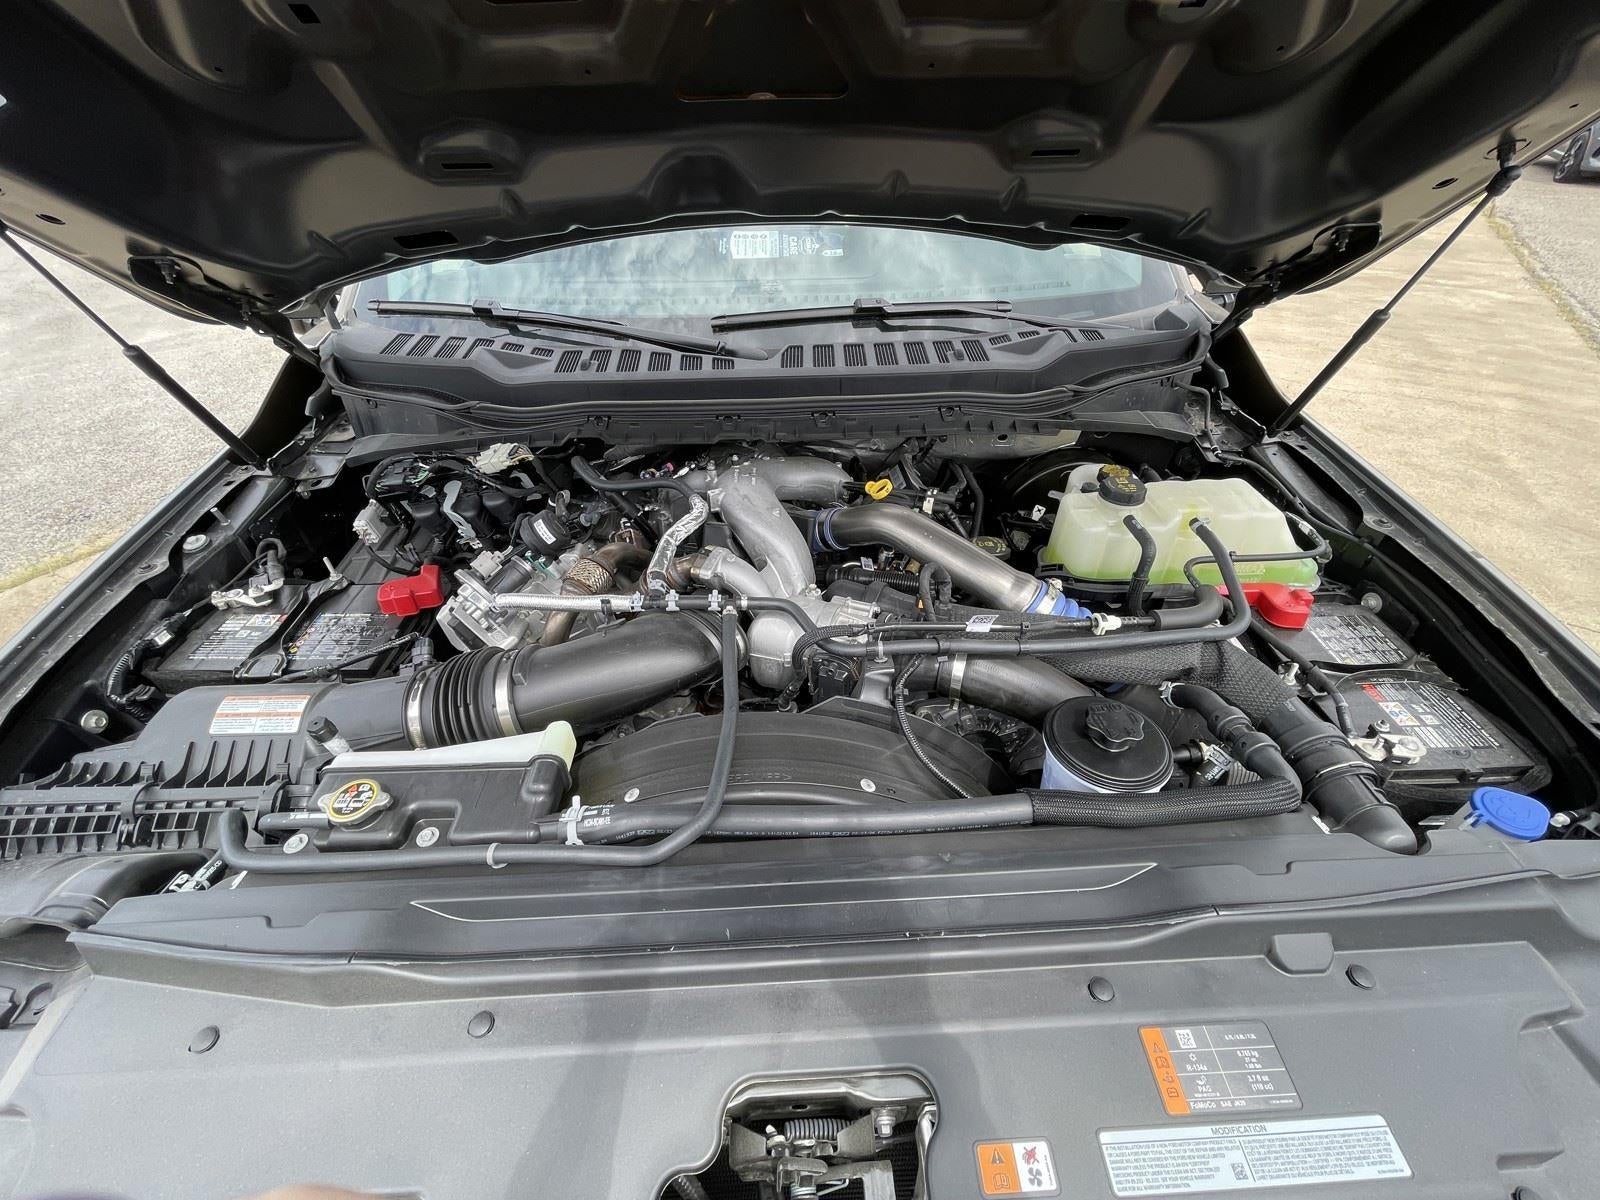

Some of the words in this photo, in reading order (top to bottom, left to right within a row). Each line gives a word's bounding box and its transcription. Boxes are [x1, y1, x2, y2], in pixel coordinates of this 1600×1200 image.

[1186, 1064, 1208, 1072] R-134a
[1197, 1085, 1212, 1093] PAG
[1211, 1125, 1267, 1135] MODIFICATION
